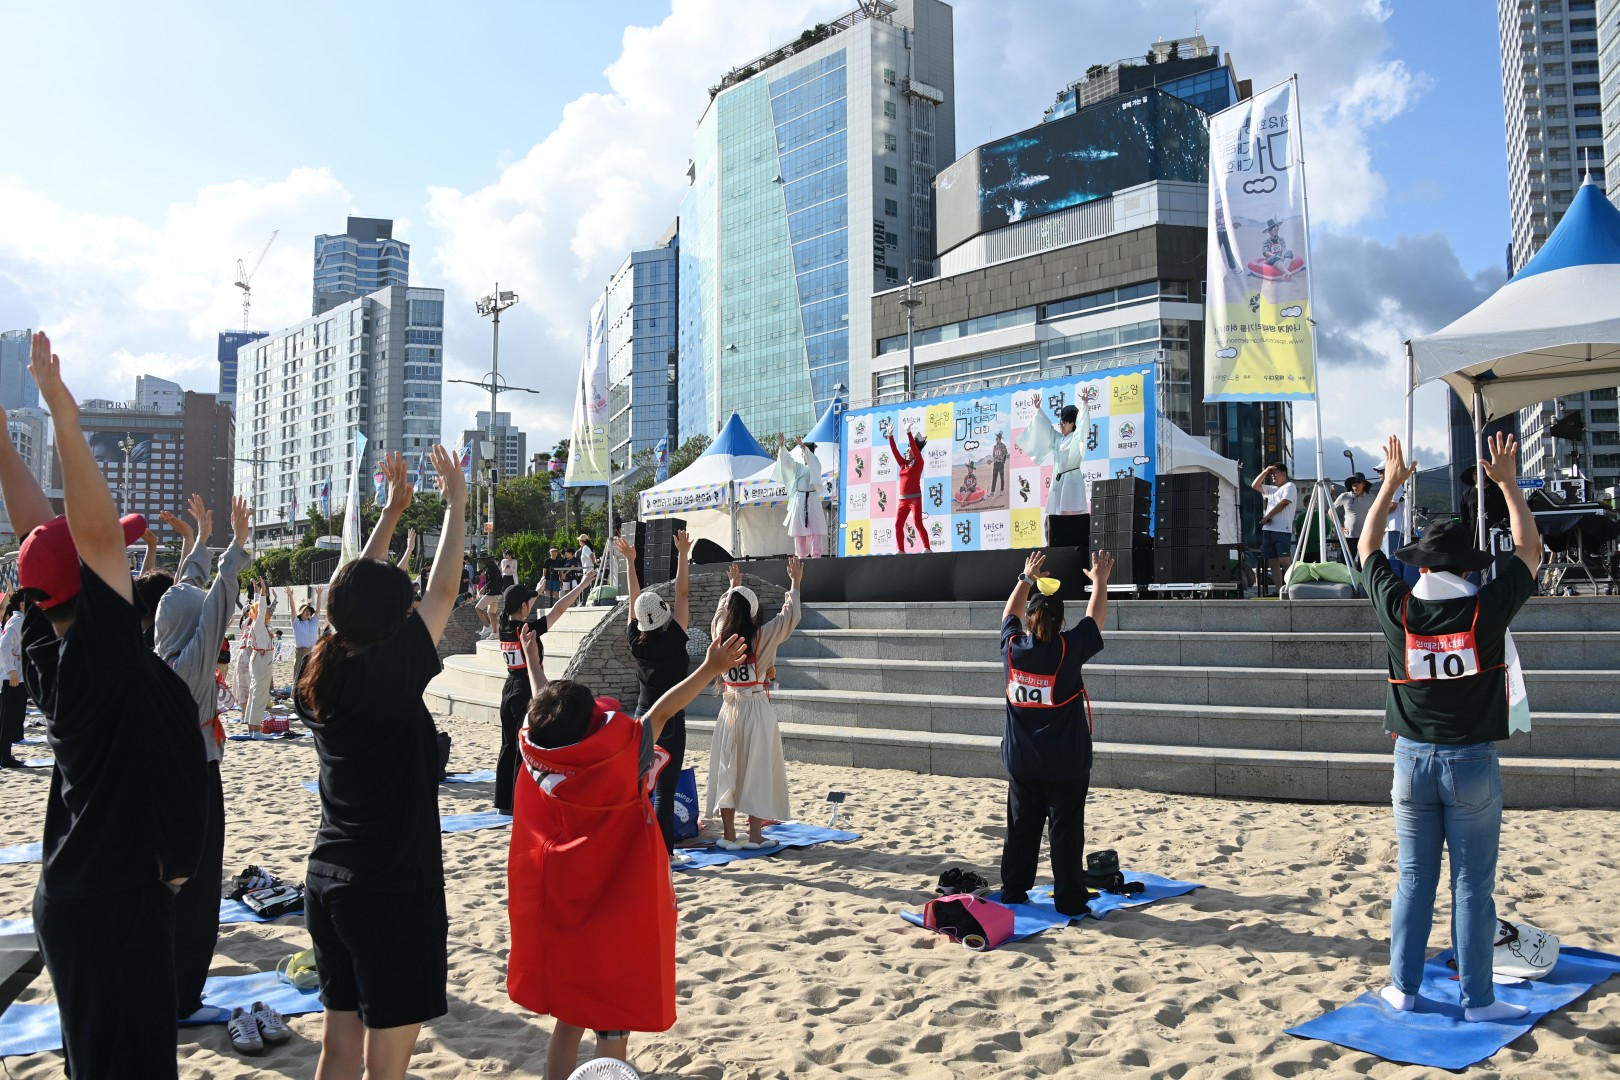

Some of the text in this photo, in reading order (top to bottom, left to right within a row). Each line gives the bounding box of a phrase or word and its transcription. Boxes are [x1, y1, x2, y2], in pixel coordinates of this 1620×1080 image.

[874, 222, 885, 271] HOTEL
[89, 400, 130, 410] GLORY
[1416, 638, 1465, 650] 멍때리기 대회
[728, 665, 750, 682] 08
[1423, 652, 1465, 679] 10
[1015, 685, 1042, 703] 09
